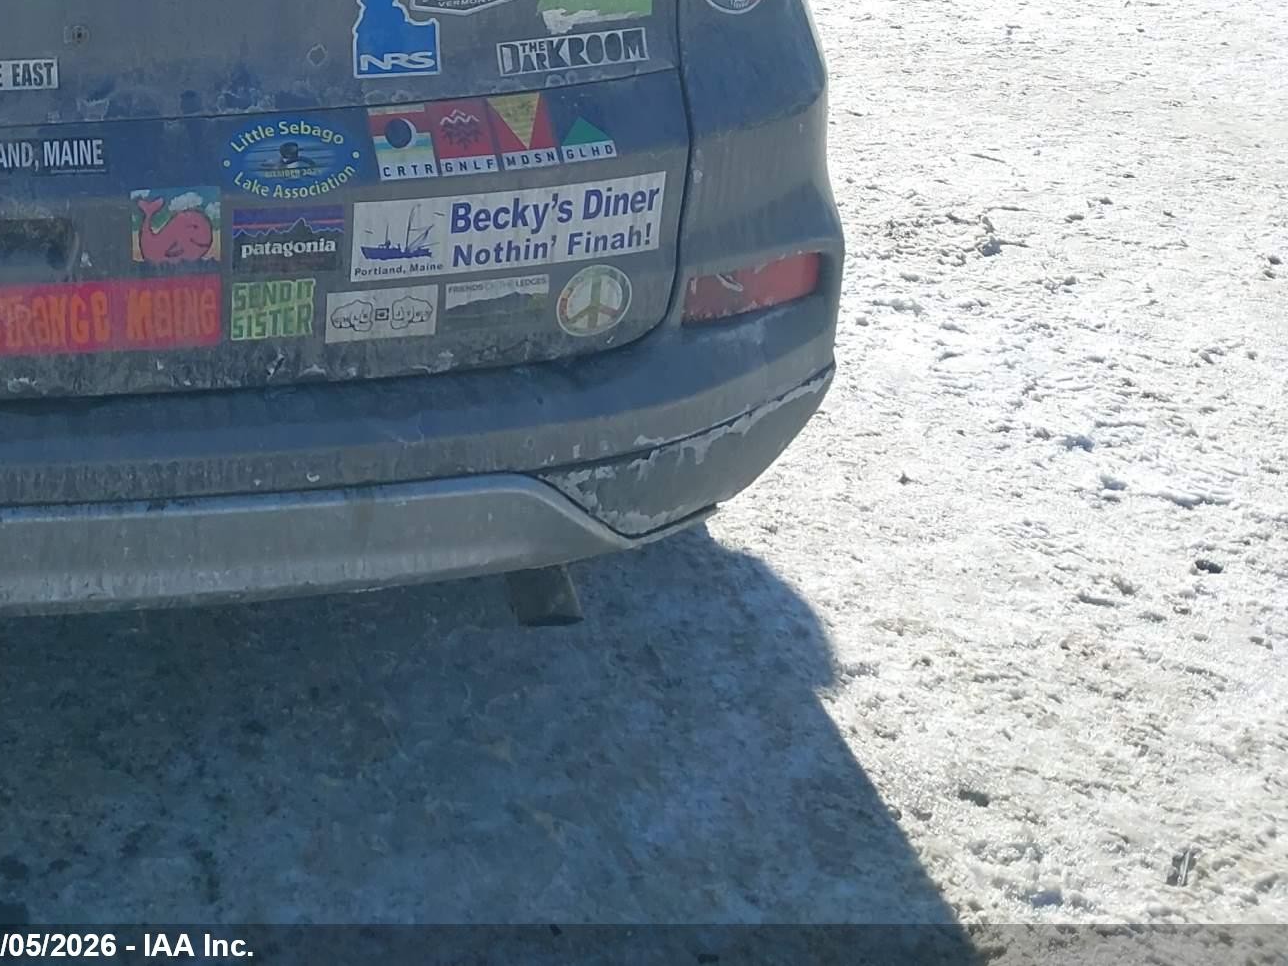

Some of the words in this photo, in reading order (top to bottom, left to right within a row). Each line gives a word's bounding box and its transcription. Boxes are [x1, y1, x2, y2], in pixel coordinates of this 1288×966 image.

[520, 40, 546, 54] THE
[12, 61, 56, 87] EAST
[360, 50, 436, 72] NRS
[230, 124, 275, 153] Little
[277, 120, 344, 145] Sebago
[43, 139, 104, 167] MAINE
[233, 171, 270, 197] Lake
[273, 164, 357, 200] Association
[450, 192, 574, 235] Becky's
[582, 185, 660, 221] Diner
[240, 237, 338, 259] patagonia
[452, 234, 557, 268] Nothin'
[567, 222, 652, 256] Finah!
[354, 265, 407, 278] Portland,
[408, 261, 444, 274] Maine
[447, 284, 484, 294] FRIENDS
[515, 277, 547, 288] LEDGES
[231, 304, 314, 340] SISTER
